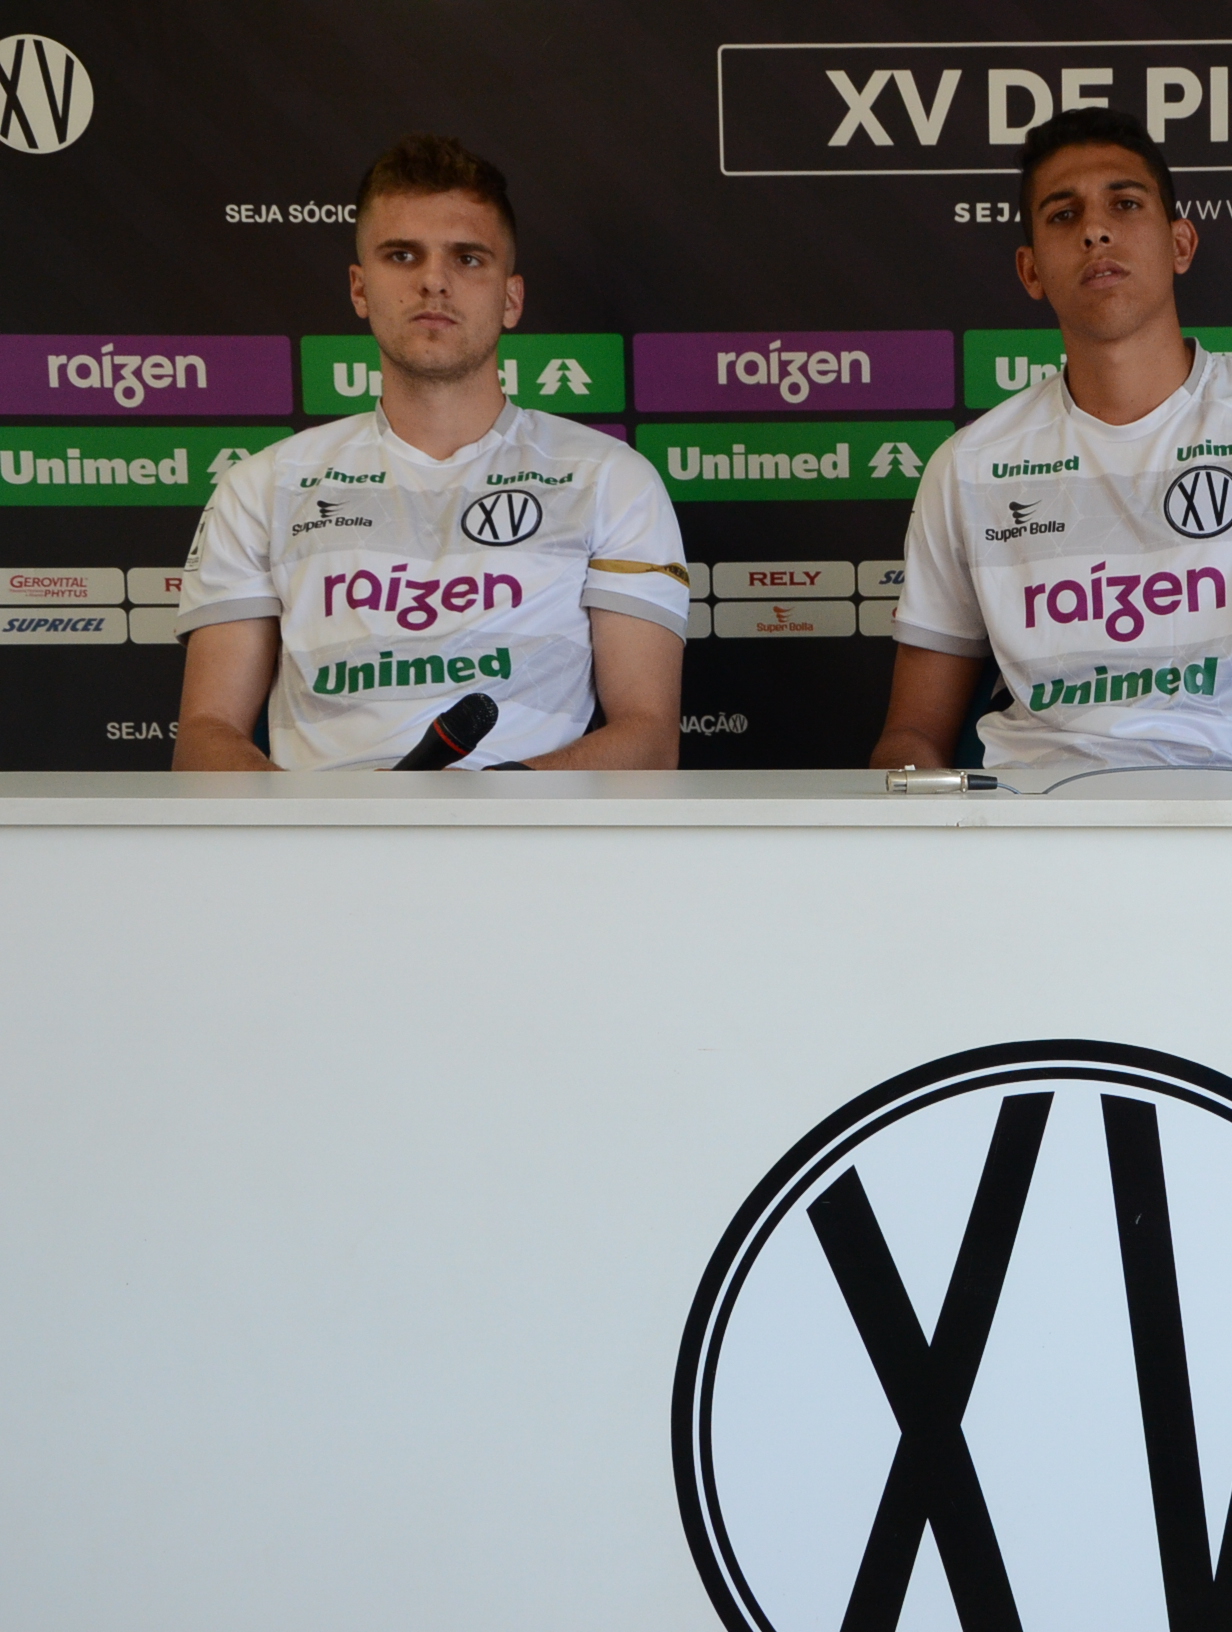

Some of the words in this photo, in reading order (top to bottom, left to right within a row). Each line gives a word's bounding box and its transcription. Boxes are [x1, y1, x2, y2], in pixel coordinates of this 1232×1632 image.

[0, 38, 75, 150] XV
[825, 69, 962, 146] XV
[225, 204, 283, 223] SEJA
[48, 343, 207, 408] raízen
[717, 340, 871, 404] raízen
[0, 448, 189, 485] Unimed
[486, 471, 574, 487] Unimed
[667, 443, 849, 481] Unimed
[991, 455, 1080, 478] Unimed
[476, 493, 530, 540] XV
[1177, 471, 1230, 532] XV
[291, 516, 333, 537] Super
[334, 516, 373, 527] Bolla
[985, 522, 1028, 542] Super
[1029, 520, 1065, 535] Bolla
[9, 575, 88, 589] GEROVITAL
[44, 589, 88, 598] PHYTUS
[324, 563, 523, 631] raízen
[748, 571, 822, 587] RELY
[1024, 560, 1226, 643] raízen
[2, 618, 106, 633] SUPRICEL
[756, 622, 788, 634] Super
[312, 647, 512, 695] Unimed
[1029, 657, 1219, 712] Unimed
[106, 721, 163, 740] SEJA
